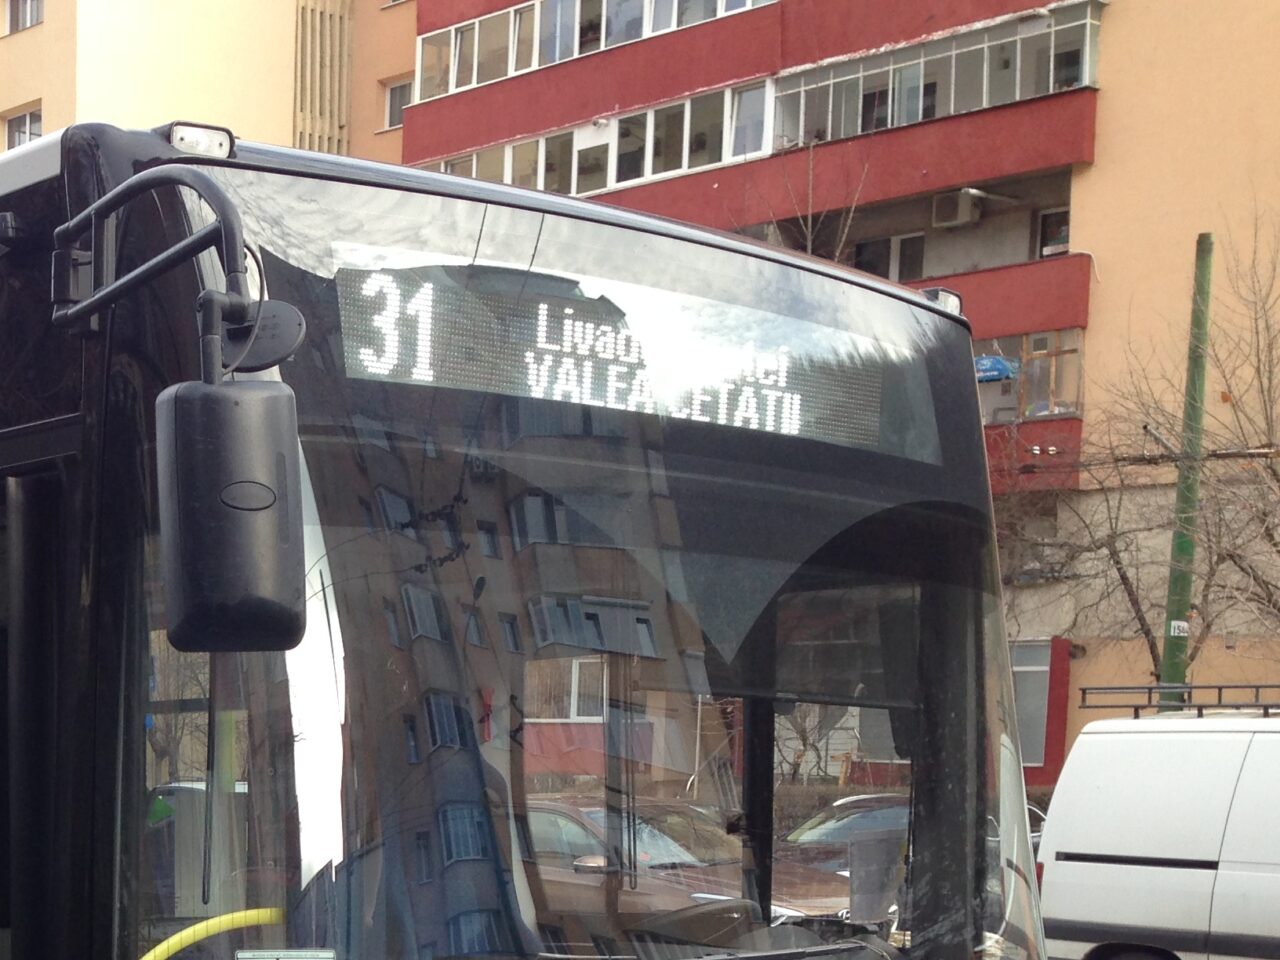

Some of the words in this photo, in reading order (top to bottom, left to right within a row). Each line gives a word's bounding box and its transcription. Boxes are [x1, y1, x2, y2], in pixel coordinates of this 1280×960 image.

[359, 272, 435, 382] 31
[536, 303, 643, 363] Livad
[524, 351, 656, 414] VALEA
